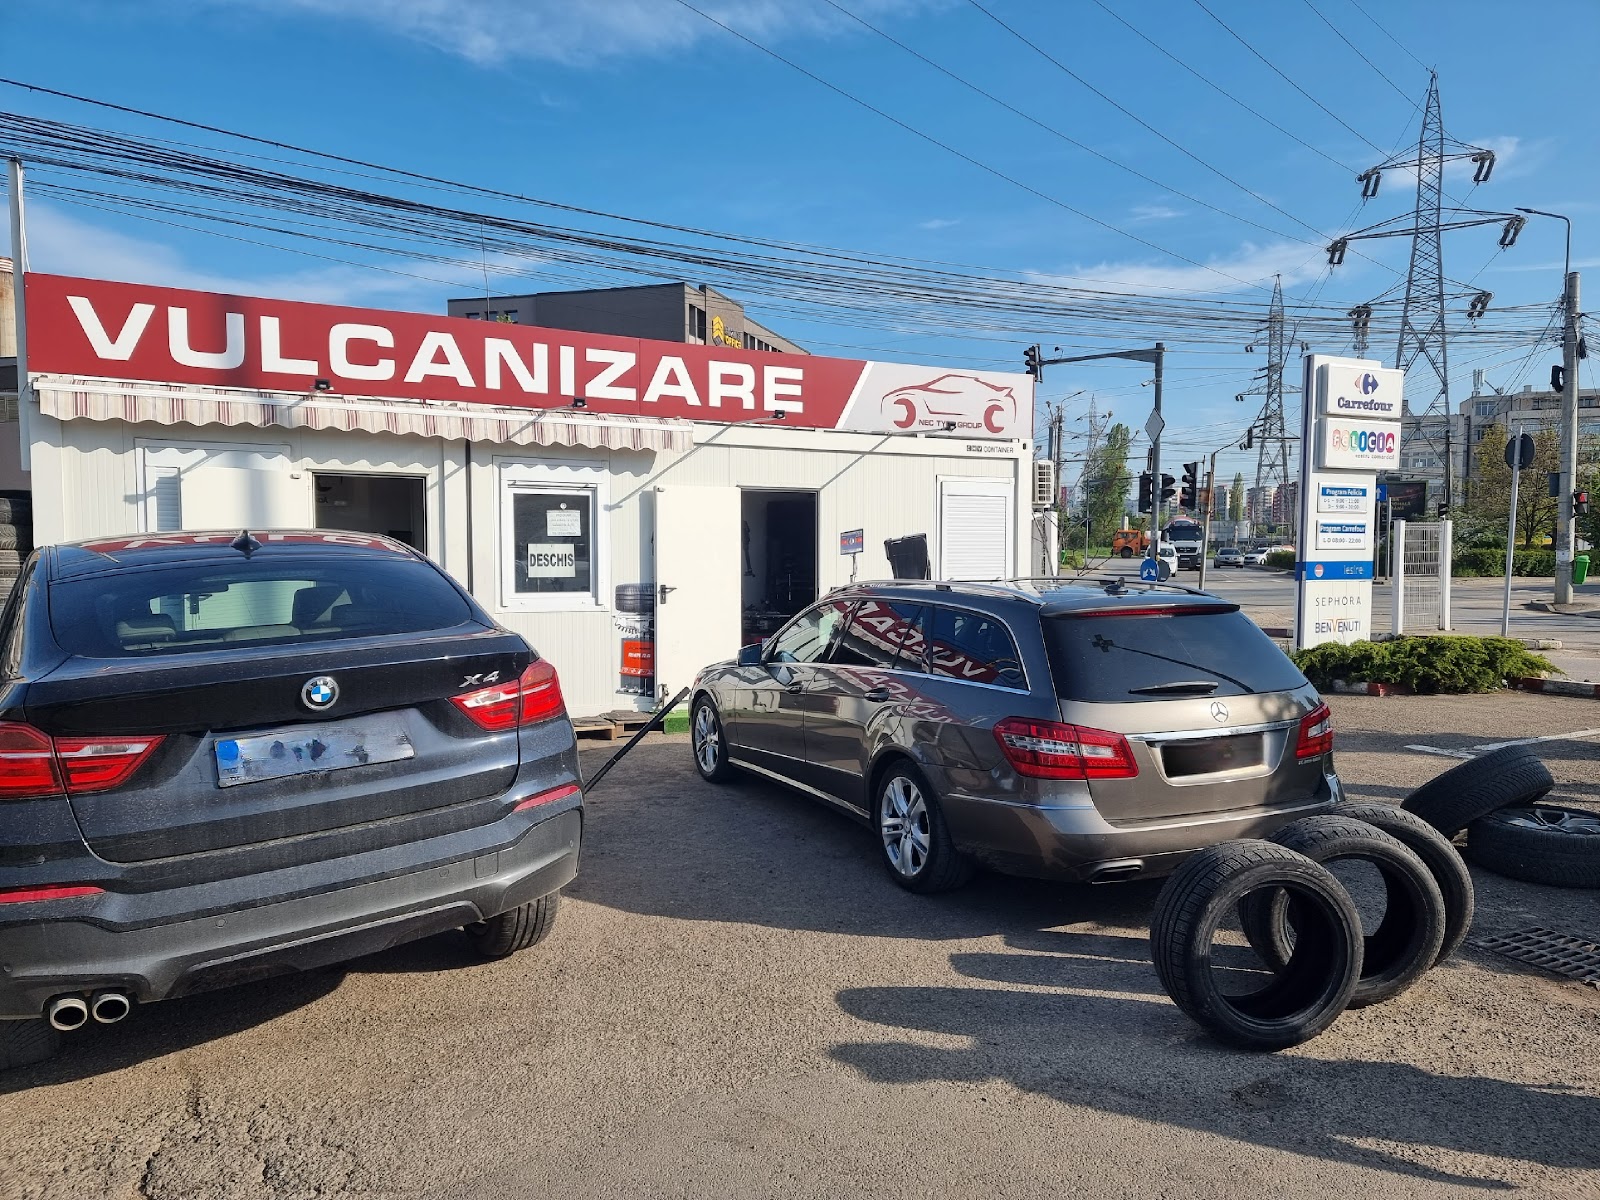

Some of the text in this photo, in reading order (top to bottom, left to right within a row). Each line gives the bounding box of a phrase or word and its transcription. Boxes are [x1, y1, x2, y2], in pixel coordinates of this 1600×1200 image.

[67, 296, 804, 414] VULCANIZARE
[1337, 396, 1393, 411] Carrefour
[957, 421, 983, 429] GROUP
[983, 446, 1014, 454] CONTAINER
[1326, 488, 1362, 496] Program Felicia
[1320, 525, 1365, 533] Program Carrefour
[529, 552, 574, 568] DESCHIS
[1315, 596, 1362, 607] SEPHORA
[1315, 617, 1361, 634] BENVENUTI
